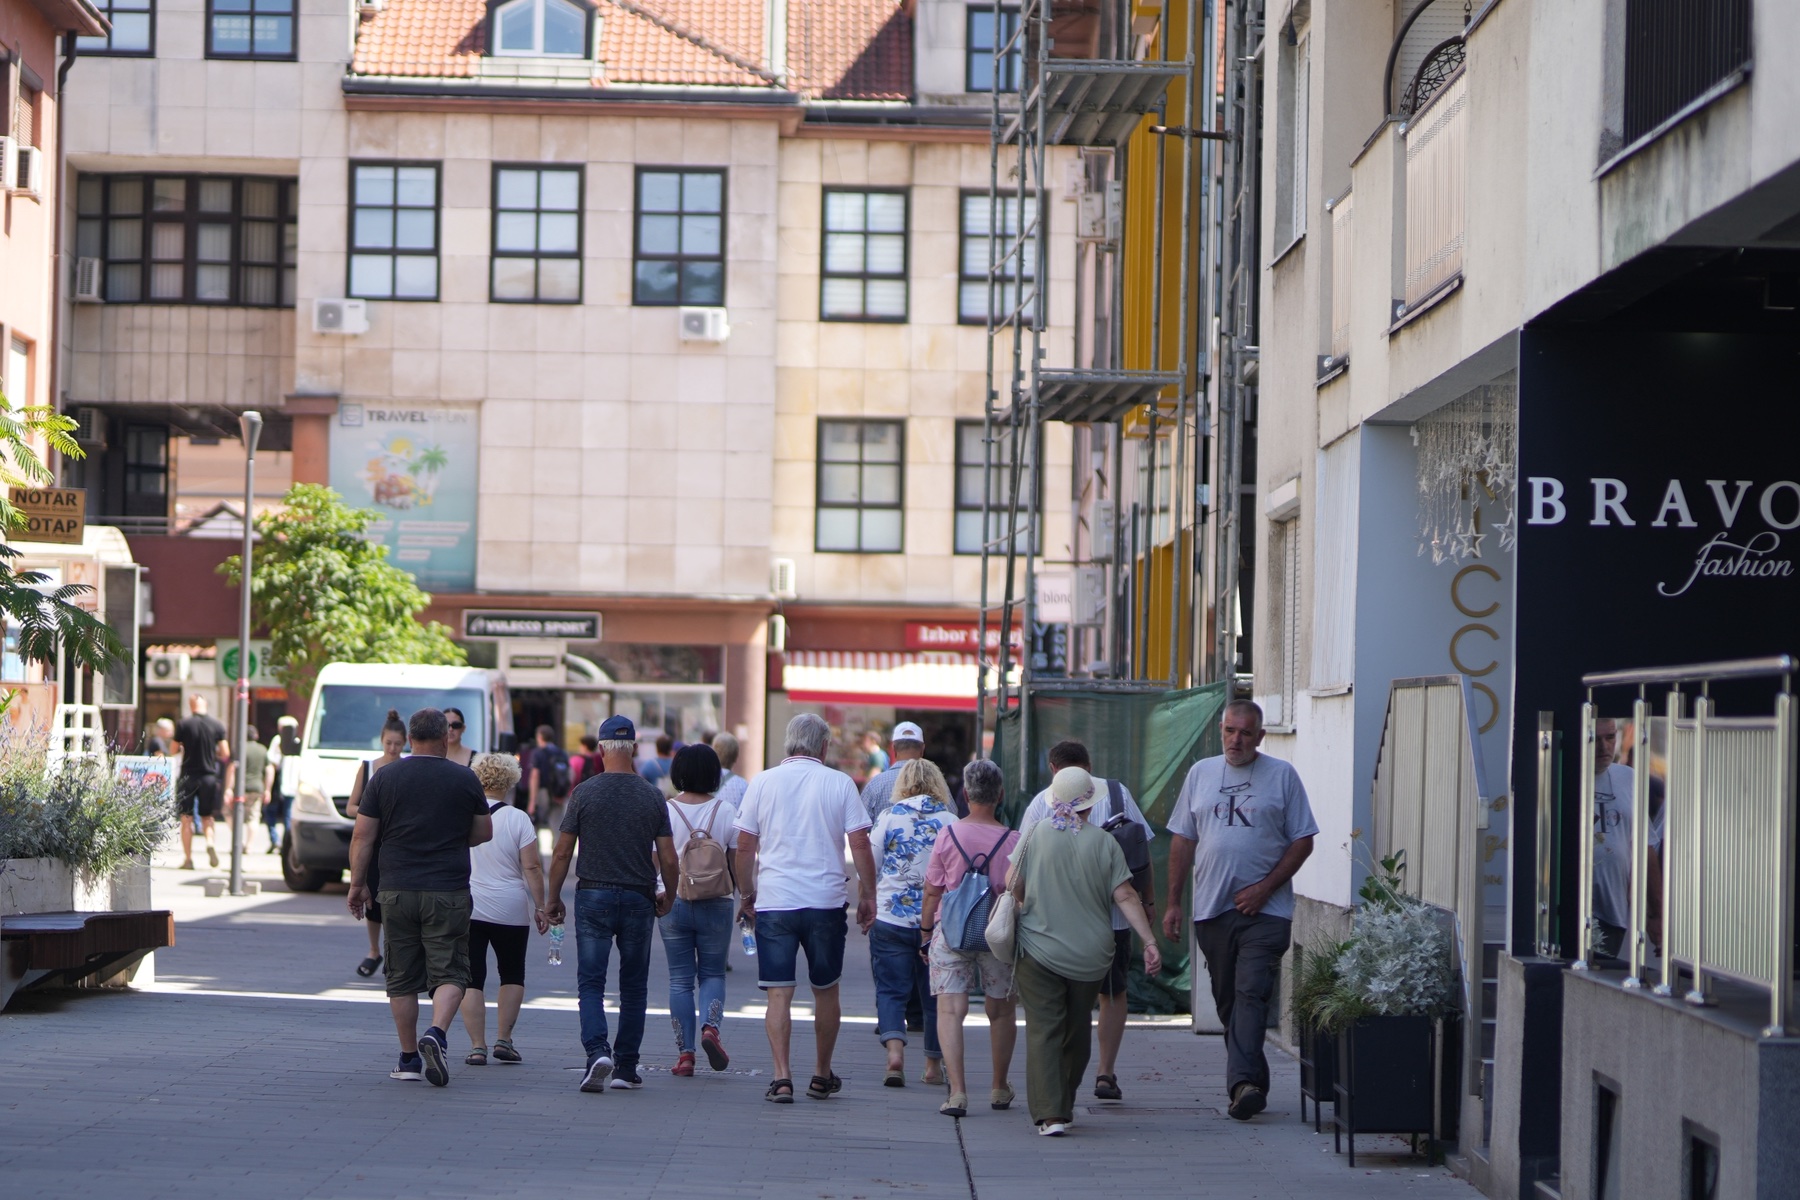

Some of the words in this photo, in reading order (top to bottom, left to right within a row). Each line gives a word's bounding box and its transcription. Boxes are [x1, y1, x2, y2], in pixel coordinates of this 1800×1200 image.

[15, 490, 78, 506] NOTAR
[1527, 476, 1800, 530] BRAVO
[1657, 531, 1795, 597] fashion
[544, 621, 588, 634] SPORT
